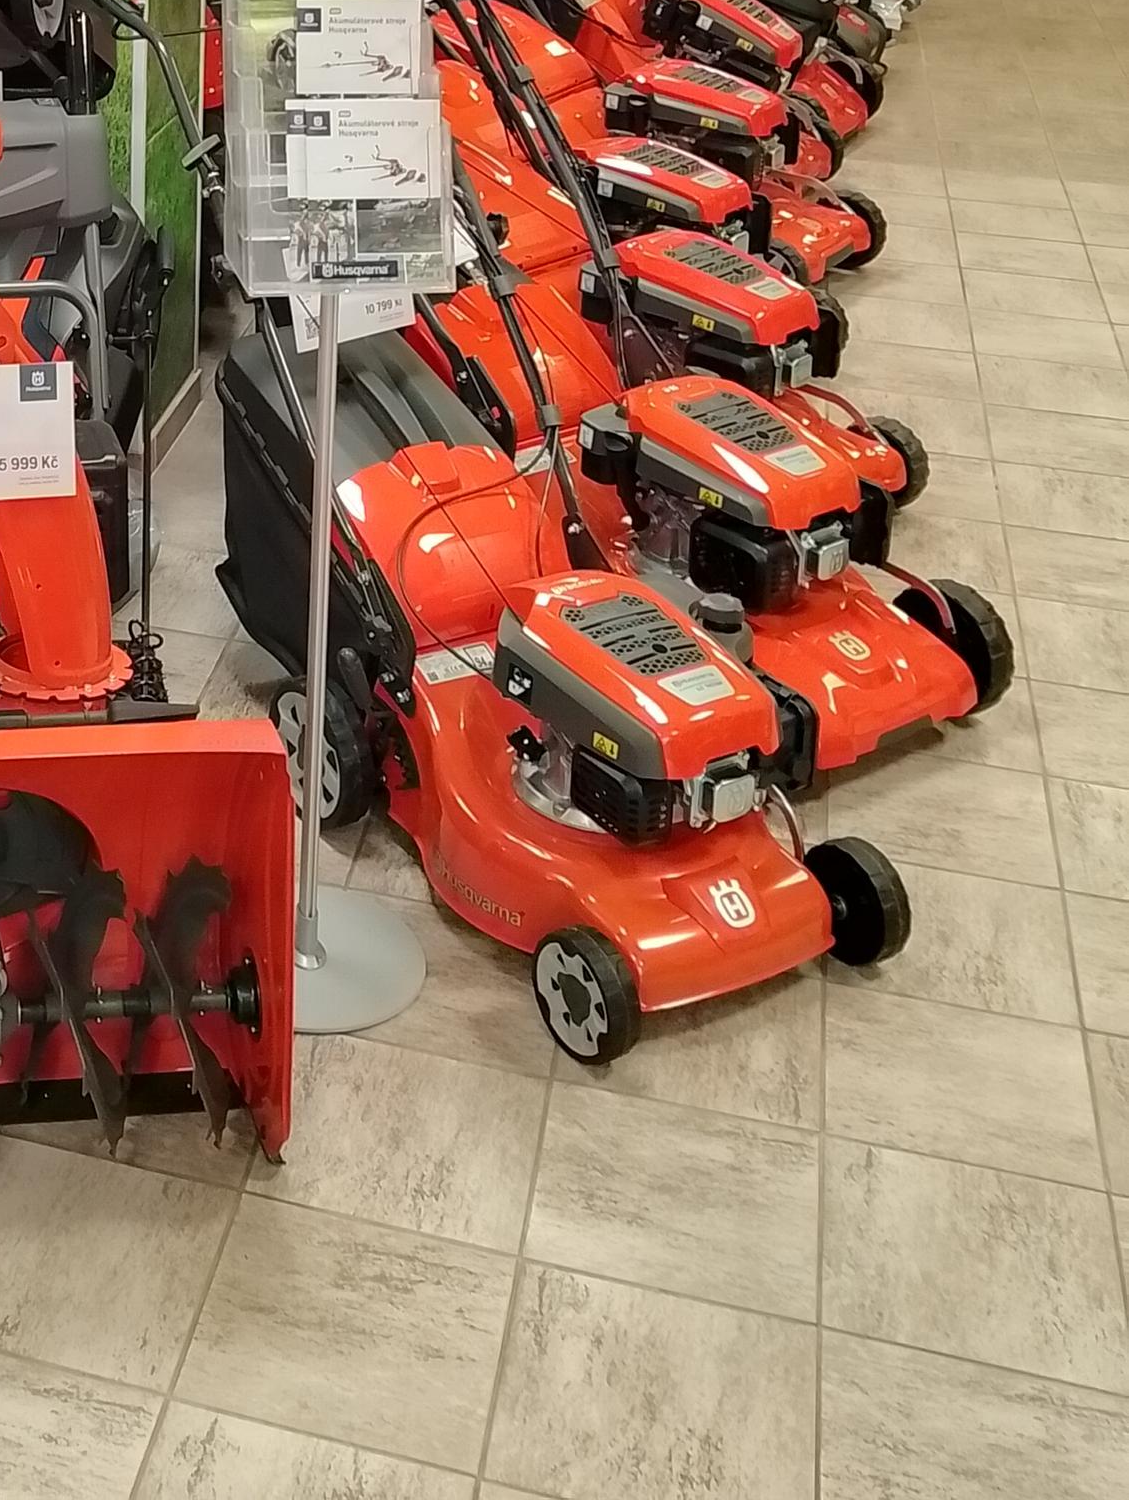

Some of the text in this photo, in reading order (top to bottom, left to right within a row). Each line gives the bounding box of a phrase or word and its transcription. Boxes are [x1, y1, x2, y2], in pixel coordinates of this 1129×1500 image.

[334, 264, 389, 276] Husqvarna
[364, 303, 376, 315] 10
[376, 299, 393, 312] 799
[11, 456, 39, 471] 999
[41, 454, 59, 469] Kč
